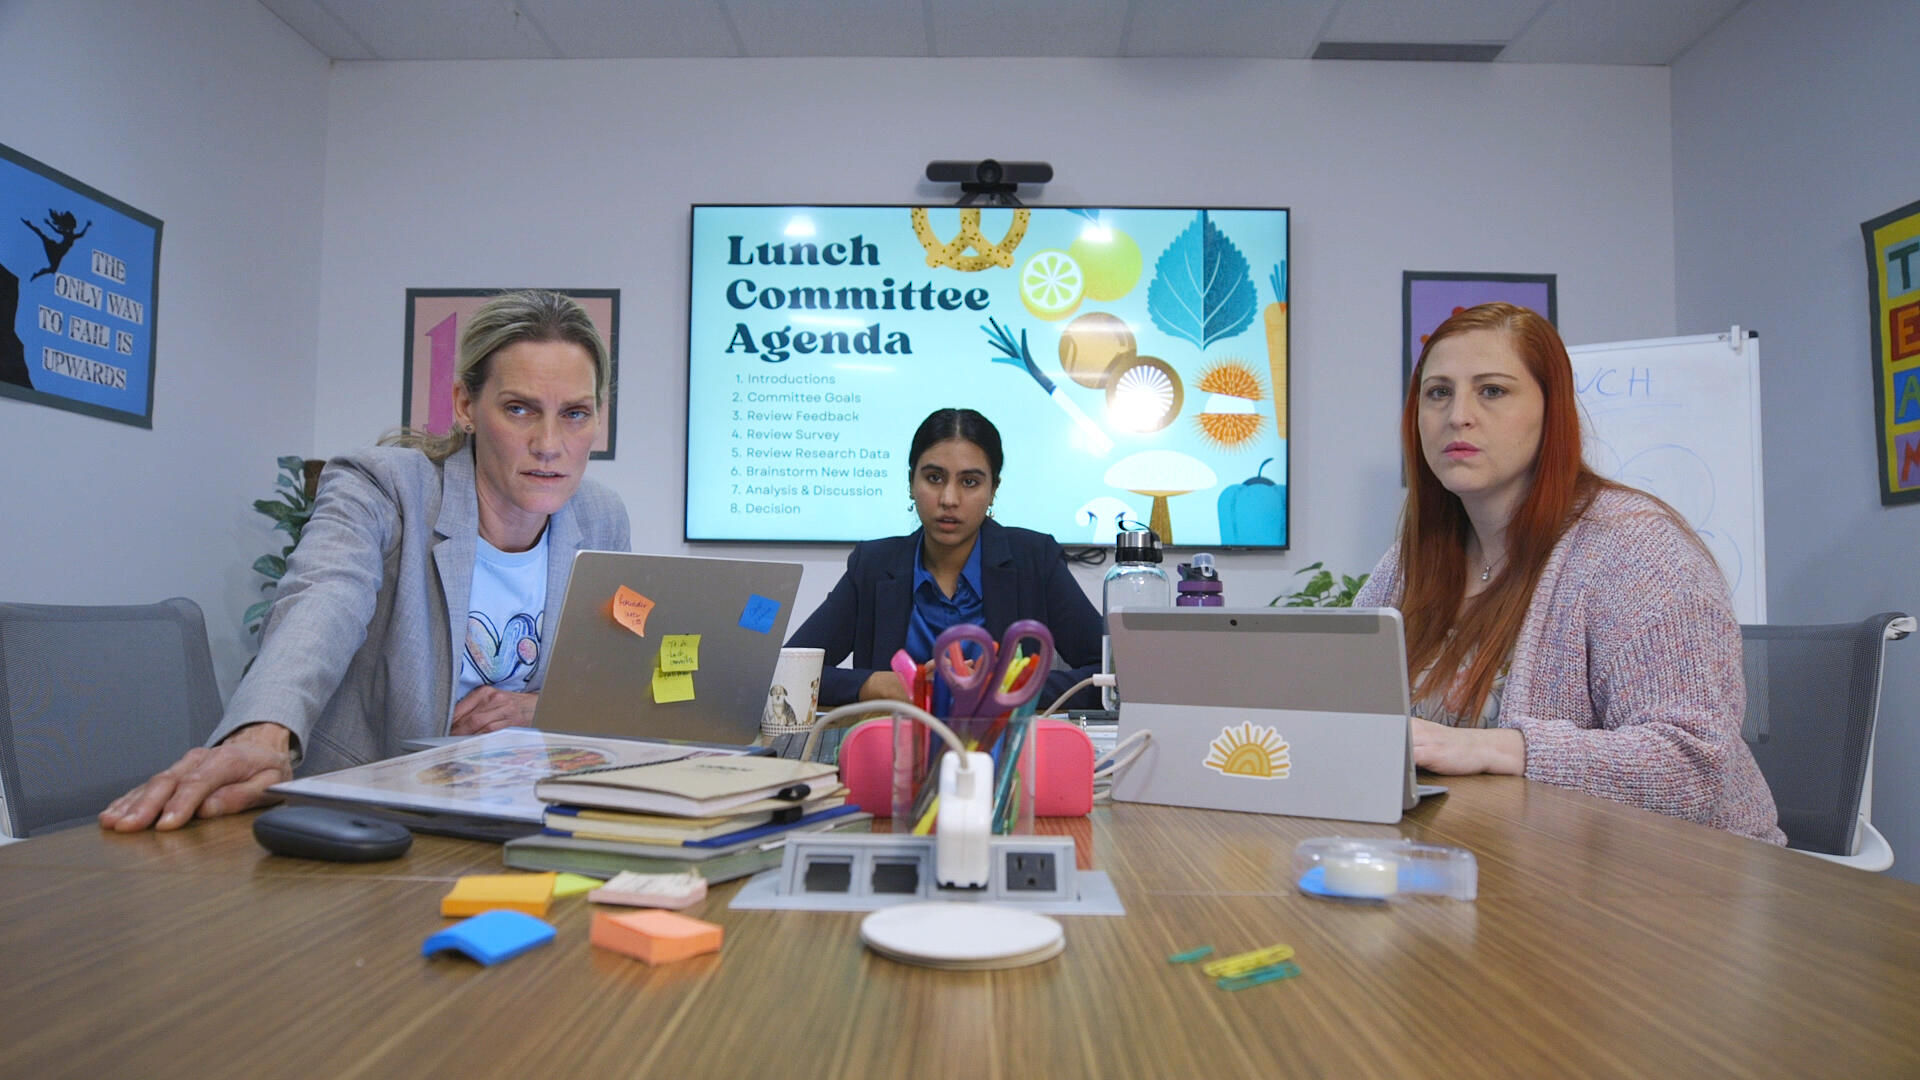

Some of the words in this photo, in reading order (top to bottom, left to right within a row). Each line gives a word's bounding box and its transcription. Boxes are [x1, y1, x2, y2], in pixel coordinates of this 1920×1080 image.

[727, 234, 881, 266] Lunch
[92, 250, 126, 283] THE
[56, 275, 102, 309] ONLY
[108, 293, 142, 323] WAY
[726, 277, 991, 311] Committee
[39, 307, 63, 333] TO
[70, 317, 108, 347] FAIL
[117, 332, 132, 353] IS
[724, 323, 913, 363] Agenda
[44, 348, 126, 390] UPWARDS
[736, 374, 743, 384] 1.
[747, 374, 836, 384] Introductions
[731, 392, 743, 403] 2.
[747, 392, 821, 403] Committee
[824, 392, 862, 403] Goals
[731, 410, 743, 421] 3.
[747, 410, 793, 421] Review
[796, 410, 860, 422] Feedback
[731, 429, 743, 439] 4.
[747, 428, 793, 440] Review
[795, 429, 840, 442] Survey
[731, 448, 743, 458] 5.
[746, 447, 792, 458] Review
[795, 448, 856, 459] Research
[859, 448, 891, 459] Data
[730, 466, 742, 477] 6.
[746, 466, 818, 477] Brainstorm
[821, 467, 850, 477] New
[853, 467, 888, 478] Ideas
[732, 484, 741, 495] 7.
[745, 484, 798, 497] Analysis
[801, 485, 810, 496] &
[813, 484, 883, 496] Discussion
[730, 503, 741, 513] 8.
[745, 503, 801, 514] Decision
